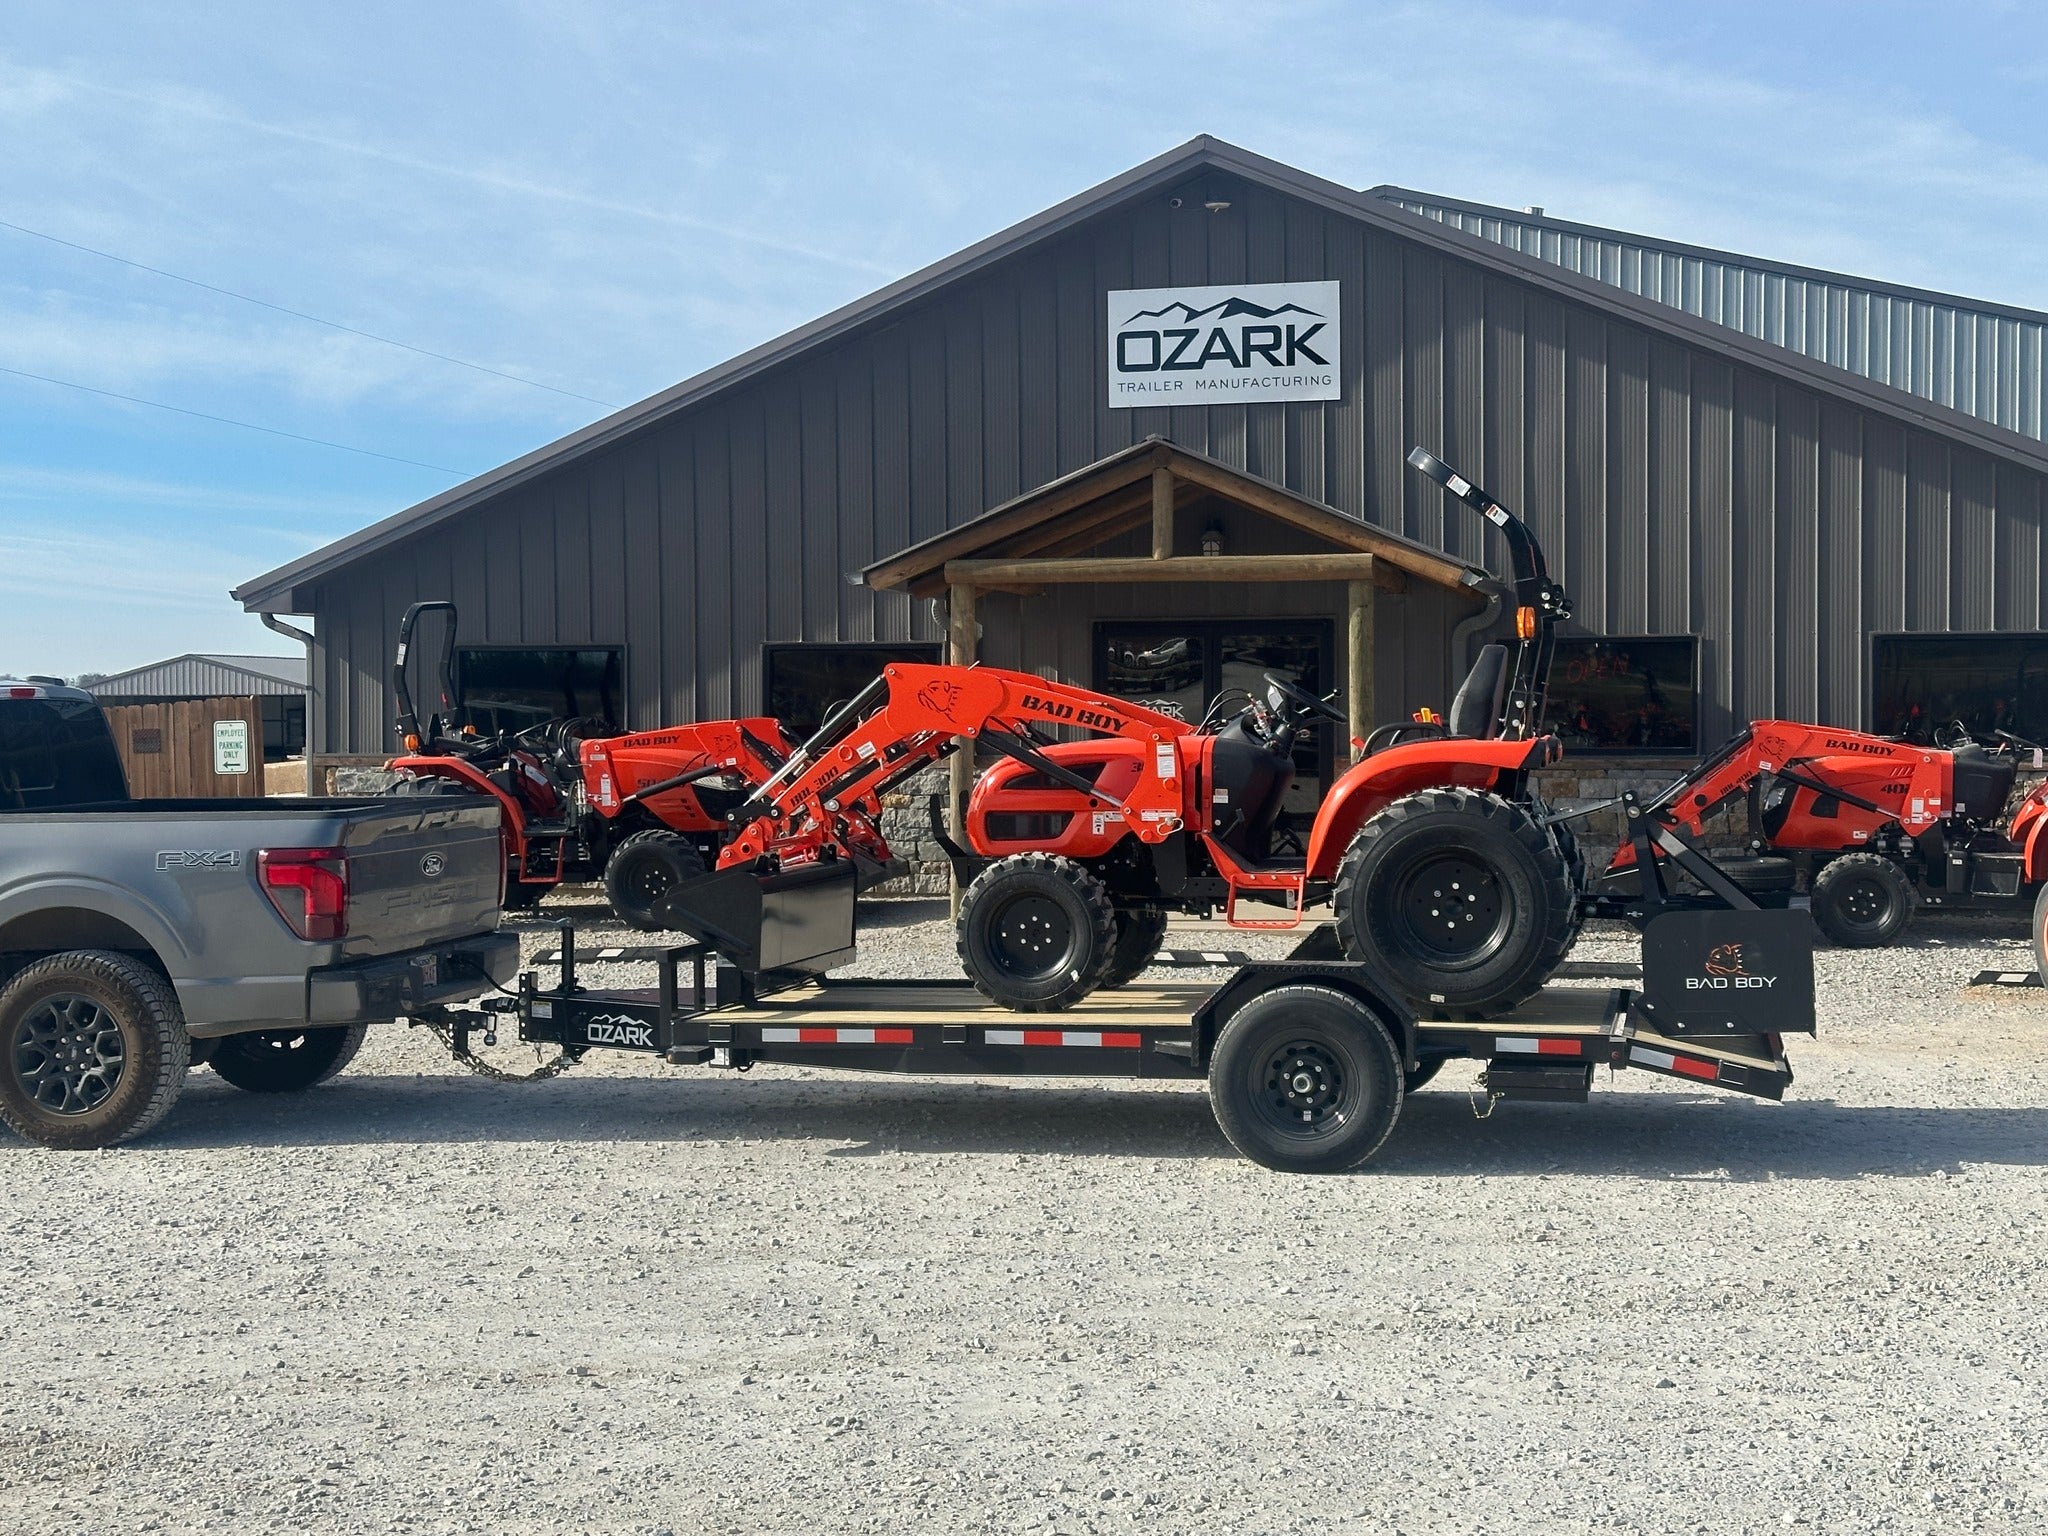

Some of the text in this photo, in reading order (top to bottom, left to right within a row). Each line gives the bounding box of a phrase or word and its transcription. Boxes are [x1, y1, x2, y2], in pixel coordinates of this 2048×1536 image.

[1116, 322, 1331, 373] OZARK
[1117, 375, 1332, 393] TRAILER MANUFACTURING
[1021, 694, 1129, 731] BAD BOY
[217, 729, 244, 737] EMPLOYEE
[623, 735, 680, 748] BAD BOY
[218, 741, 243, 750] PARKING
[224, 750, 239, 759] ONLY
[1825, 739, 1897, 757] BAD BOY
[814, 766, 839, 789] 300
[156, 850, 240, 872] FX4
[1686, 976, 1777, 989] BAD BOY
[587, 1023, 654, 1047] OZARK
